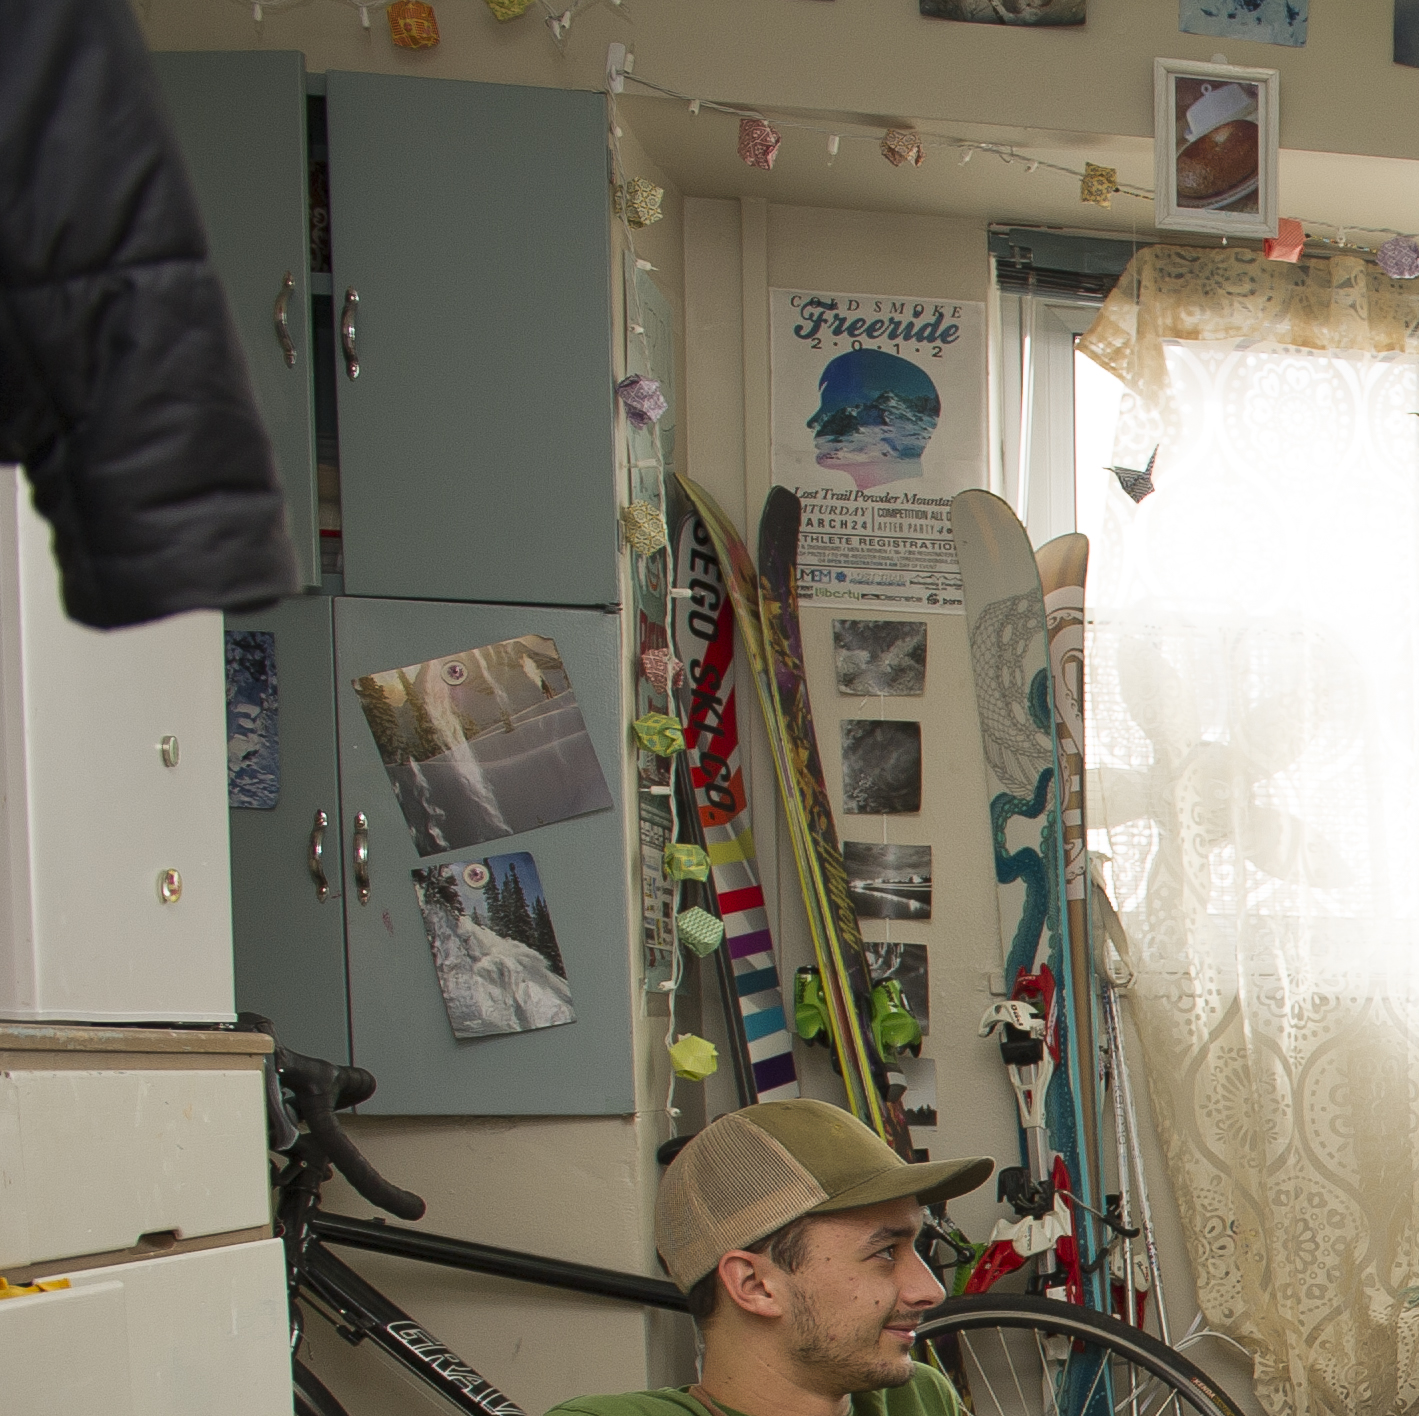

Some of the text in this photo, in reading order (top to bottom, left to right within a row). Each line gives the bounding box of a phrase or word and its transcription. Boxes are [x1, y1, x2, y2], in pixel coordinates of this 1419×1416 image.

[790, 295, 962, 318] COLD SMOKE
[793, 299, 960, 345] Freeride
[794, 487, 819, 499] Lost
[821, 488, 851, 500] Trail
[854, 490, 900, 503] Powder
[801, 503, 868, 517] ATURDAY
[877, 507, 944, 521] COMPETITION ALL
[805, 517, 848, 530] ARCH
[877, 521, 903, 532] AFTER
[908, 522, 934, 534] PARTY
[800, 534, 957, 551] THLETE REGISTRATIO
[690, 659, 725, 737] SKI
[701, 751, 735, 820] CO.
